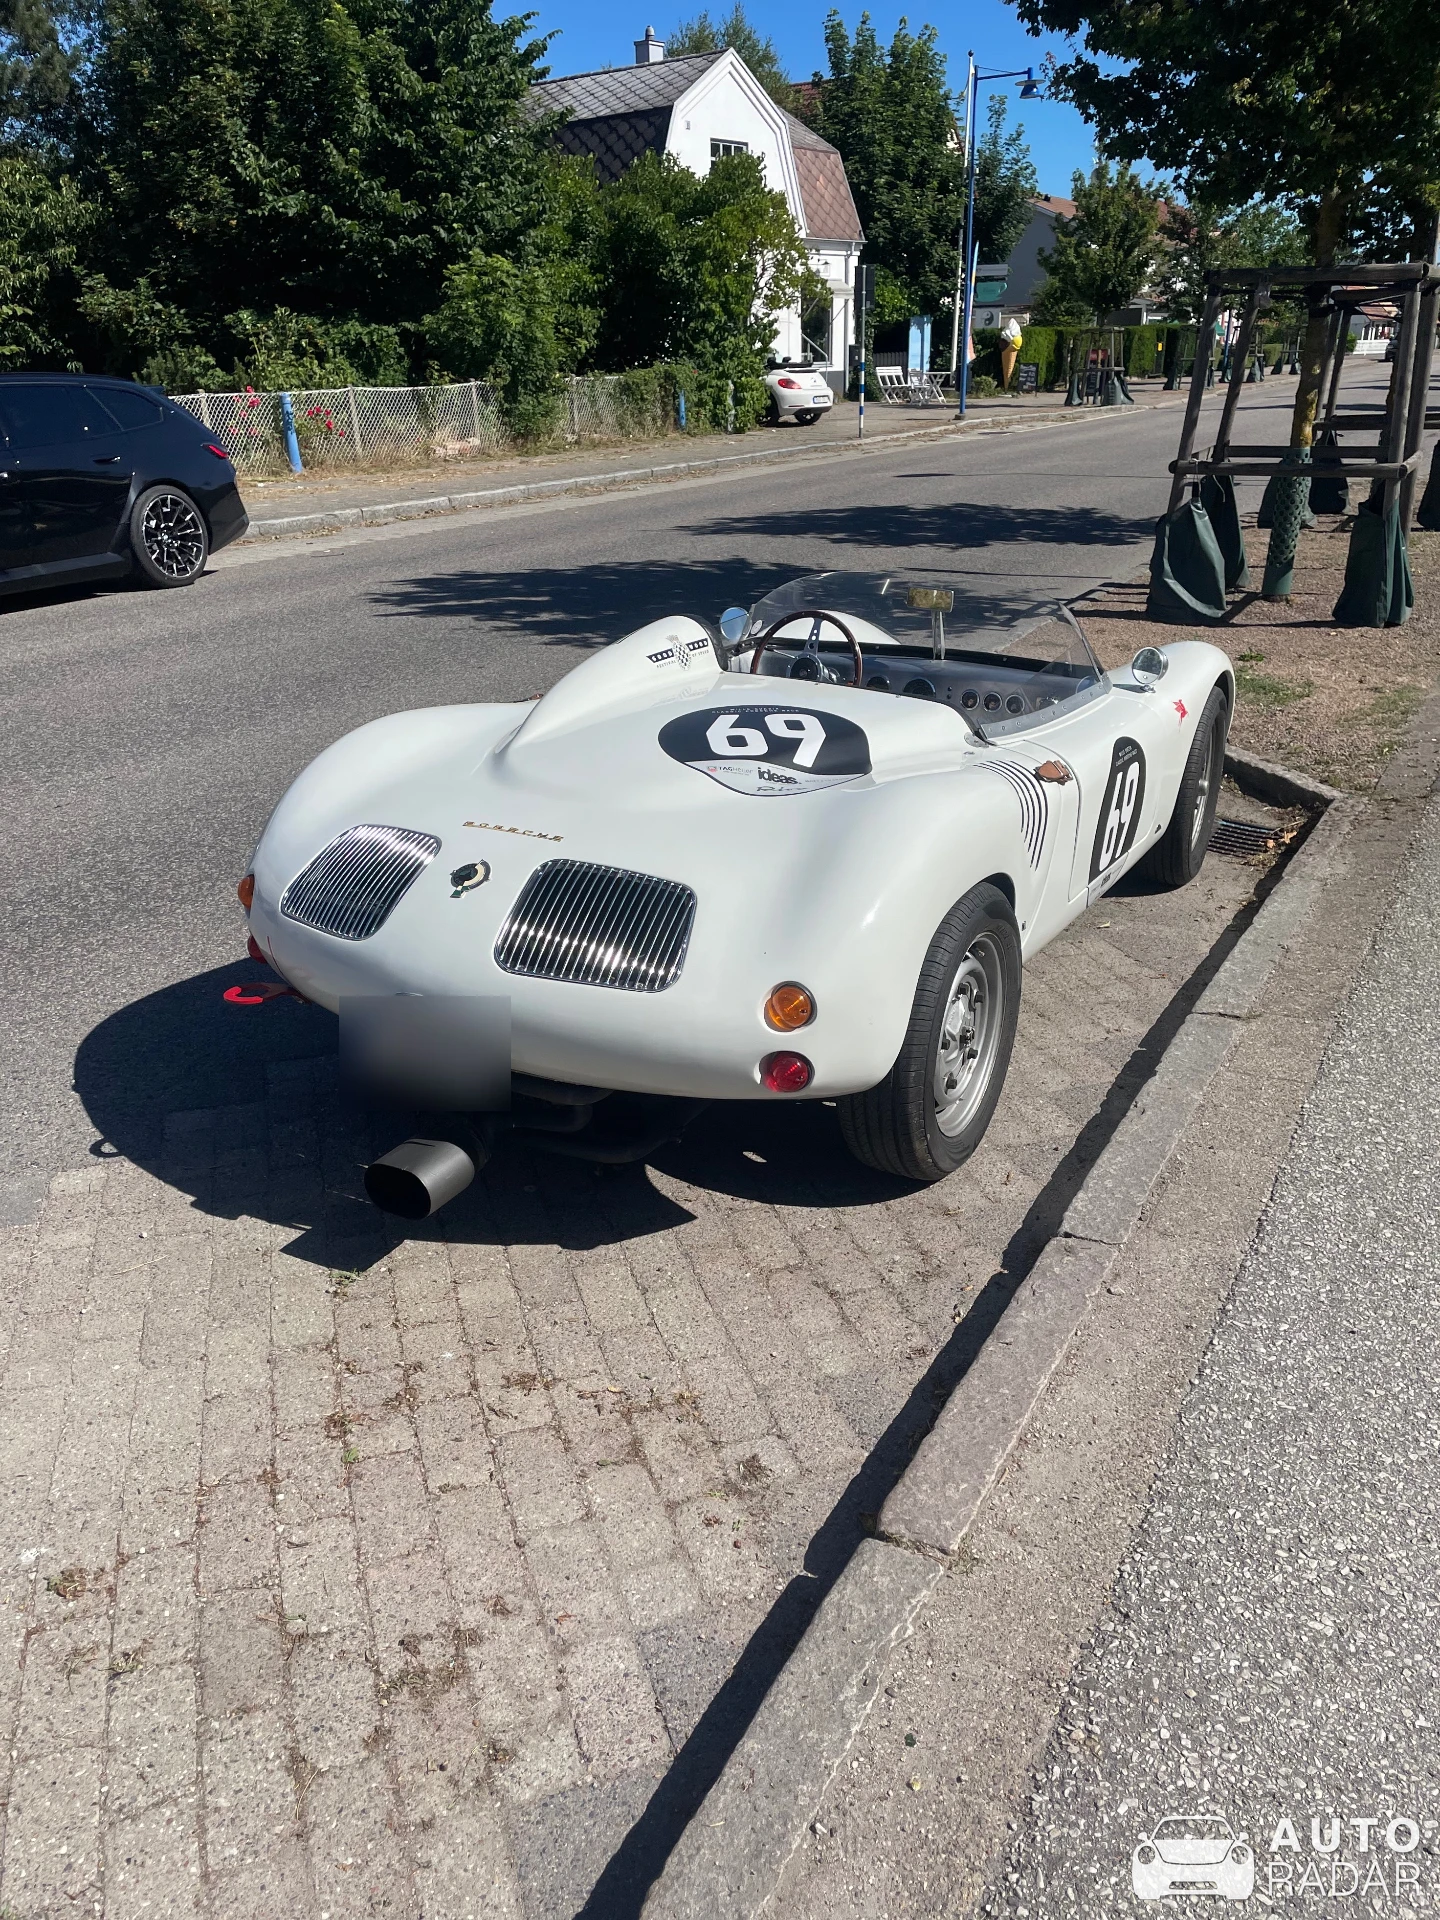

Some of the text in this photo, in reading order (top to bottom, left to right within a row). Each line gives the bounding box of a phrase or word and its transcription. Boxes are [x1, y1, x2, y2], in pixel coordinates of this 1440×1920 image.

[706, 713, 827, 768] 69
[462, 820, 564, 842] PORSCHE
[1099, 762, 1140, 872] 69
